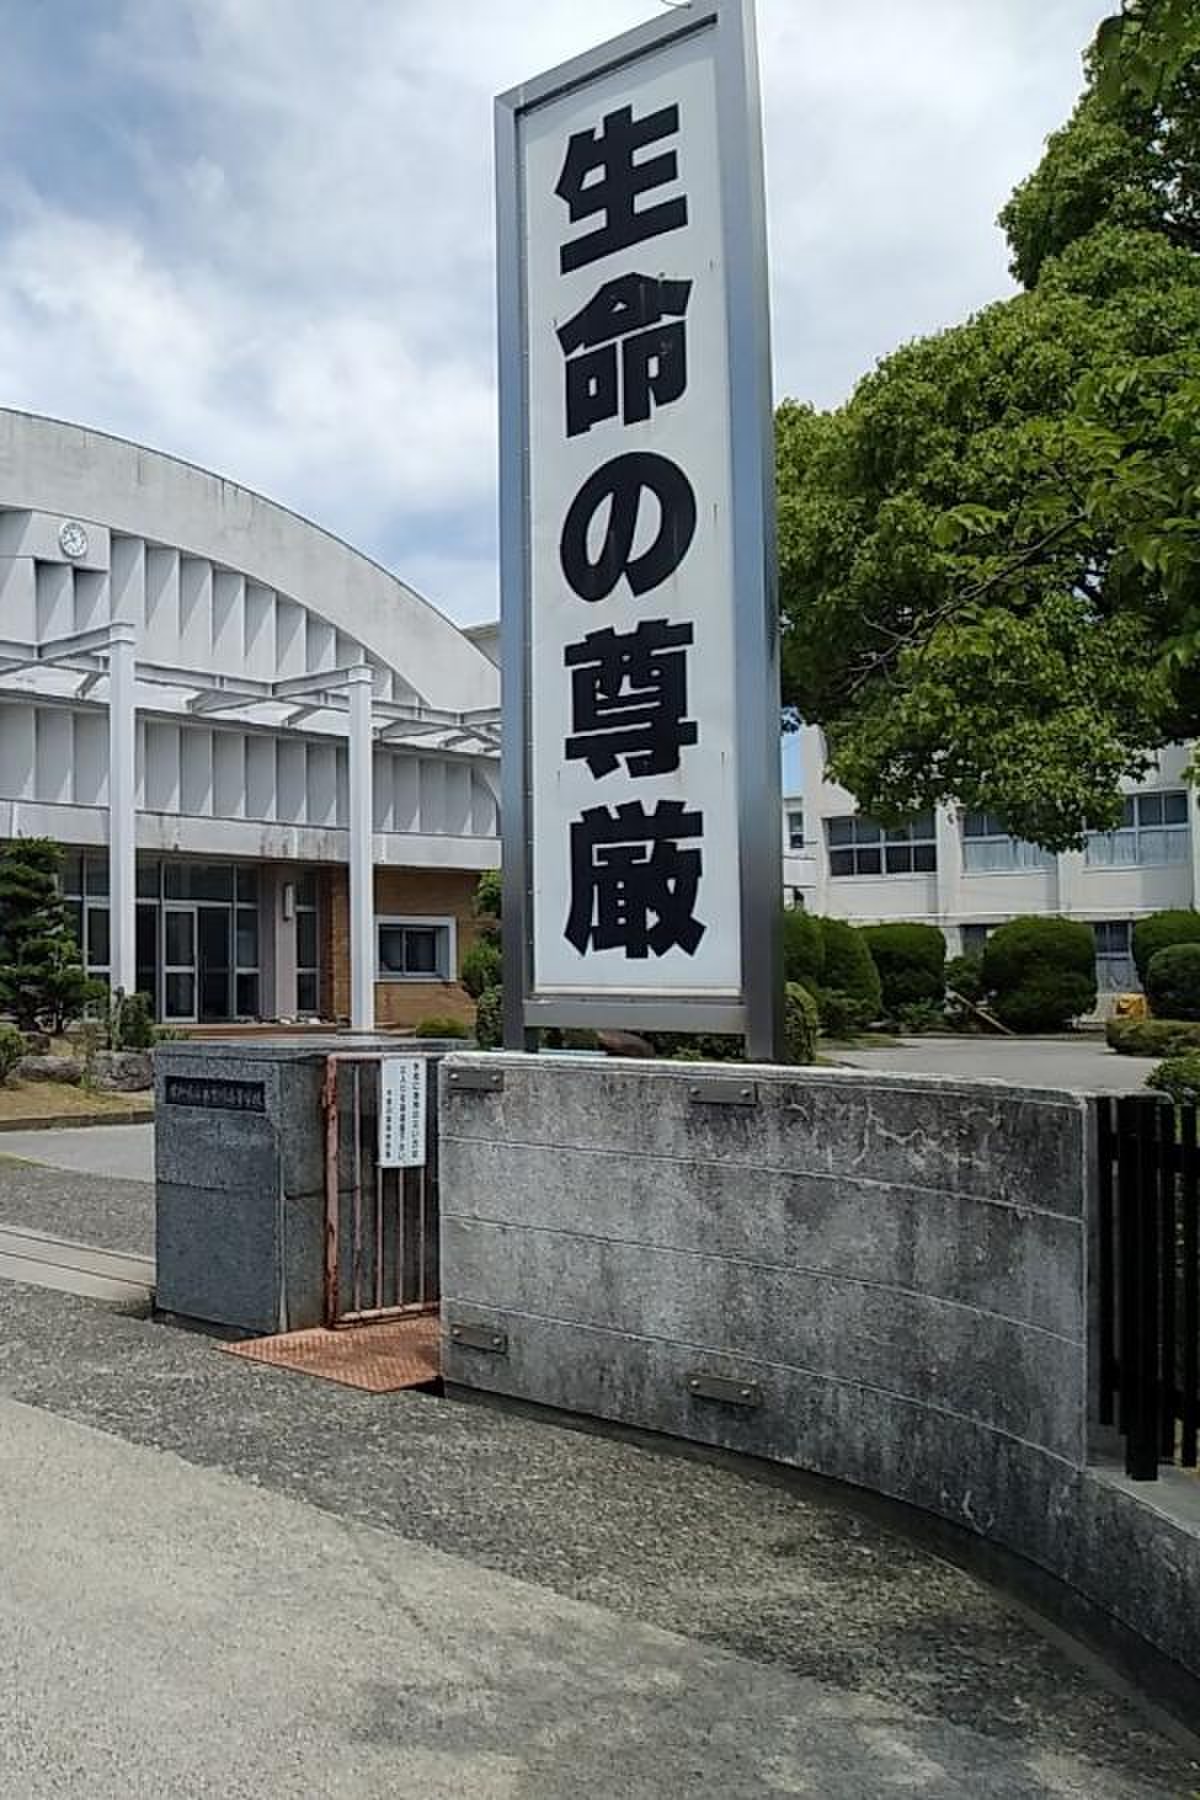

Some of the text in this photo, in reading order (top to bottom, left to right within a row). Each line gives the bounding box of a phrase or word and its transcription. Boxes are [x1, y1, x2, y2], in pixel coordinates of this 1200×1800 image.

[554, 104, 707, 959] 生命の尊厳
